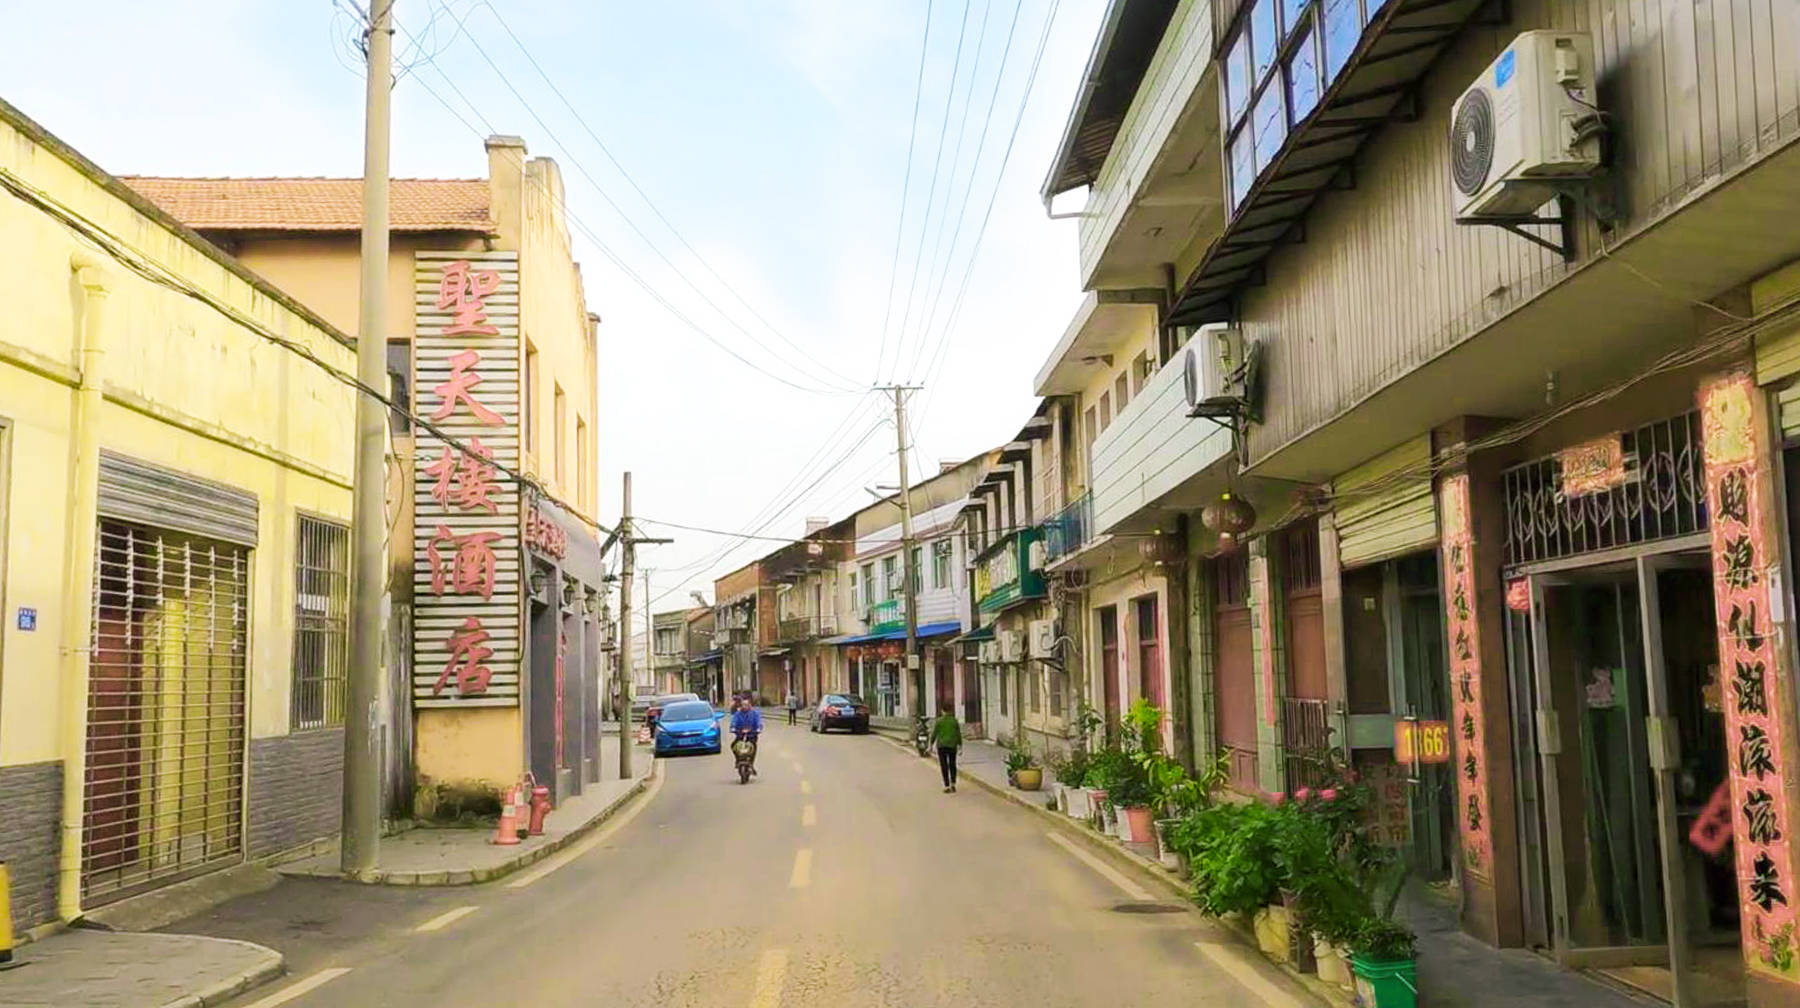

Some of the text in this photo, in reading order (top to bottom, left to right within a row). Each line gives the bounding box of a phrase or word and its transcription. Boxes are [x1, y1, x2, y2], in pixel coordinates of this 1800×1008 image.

[424, 259, 506, 696] 聖天樓酒店
